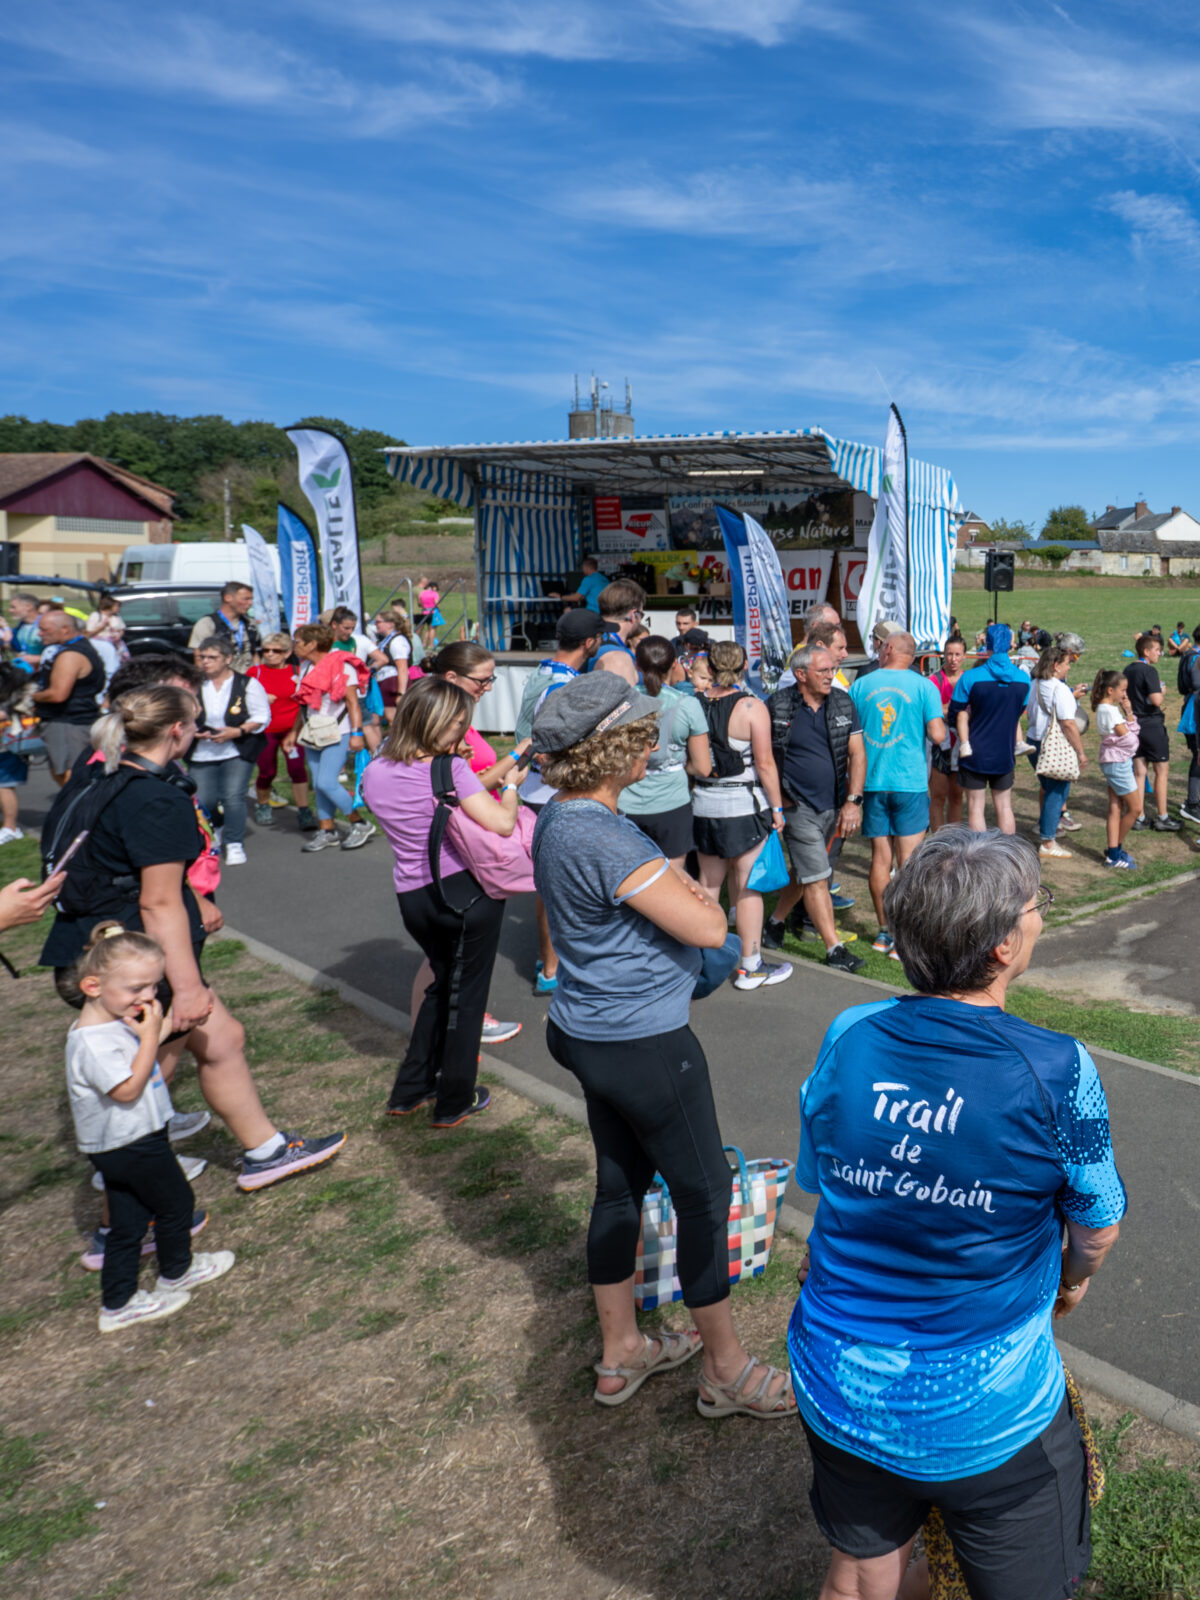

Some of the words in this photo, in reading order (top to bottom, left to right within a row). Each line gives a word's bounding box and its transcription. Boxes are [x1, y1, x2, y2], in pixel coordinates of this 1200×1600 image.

[738, 497, 768, 507] Baudets
[800, 519, 850, 540] Nature
[644, 616, 652, 628] 1
[872, 1081, 965, 1136] Trail
[890, 1134, 922, 1165] de
[830, 1157, 893, 1196] Saint
[894, 1171, 997, 1214] Gobain
